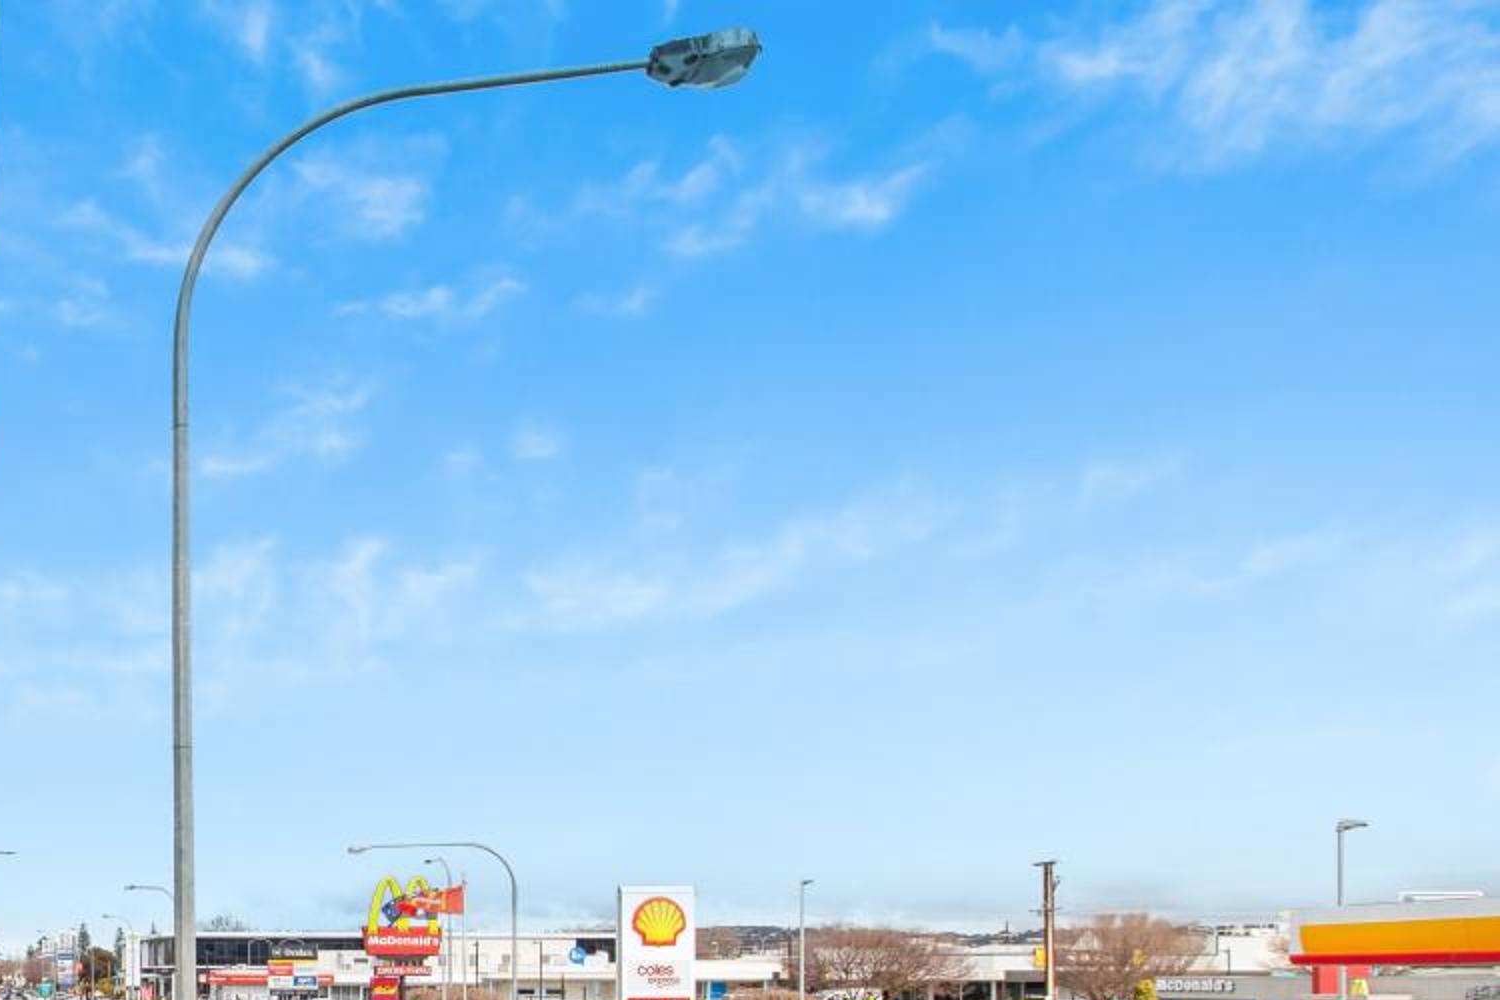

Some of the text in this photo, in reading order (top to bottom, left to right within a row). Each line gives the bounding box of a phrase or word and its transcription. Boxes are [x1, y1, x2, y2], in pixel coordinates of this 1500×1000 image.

[367, 935, 439, 945] McDonald's
[637, 964, 675, 976] coles
[1156, 979, 1235, 992] McDonald's
